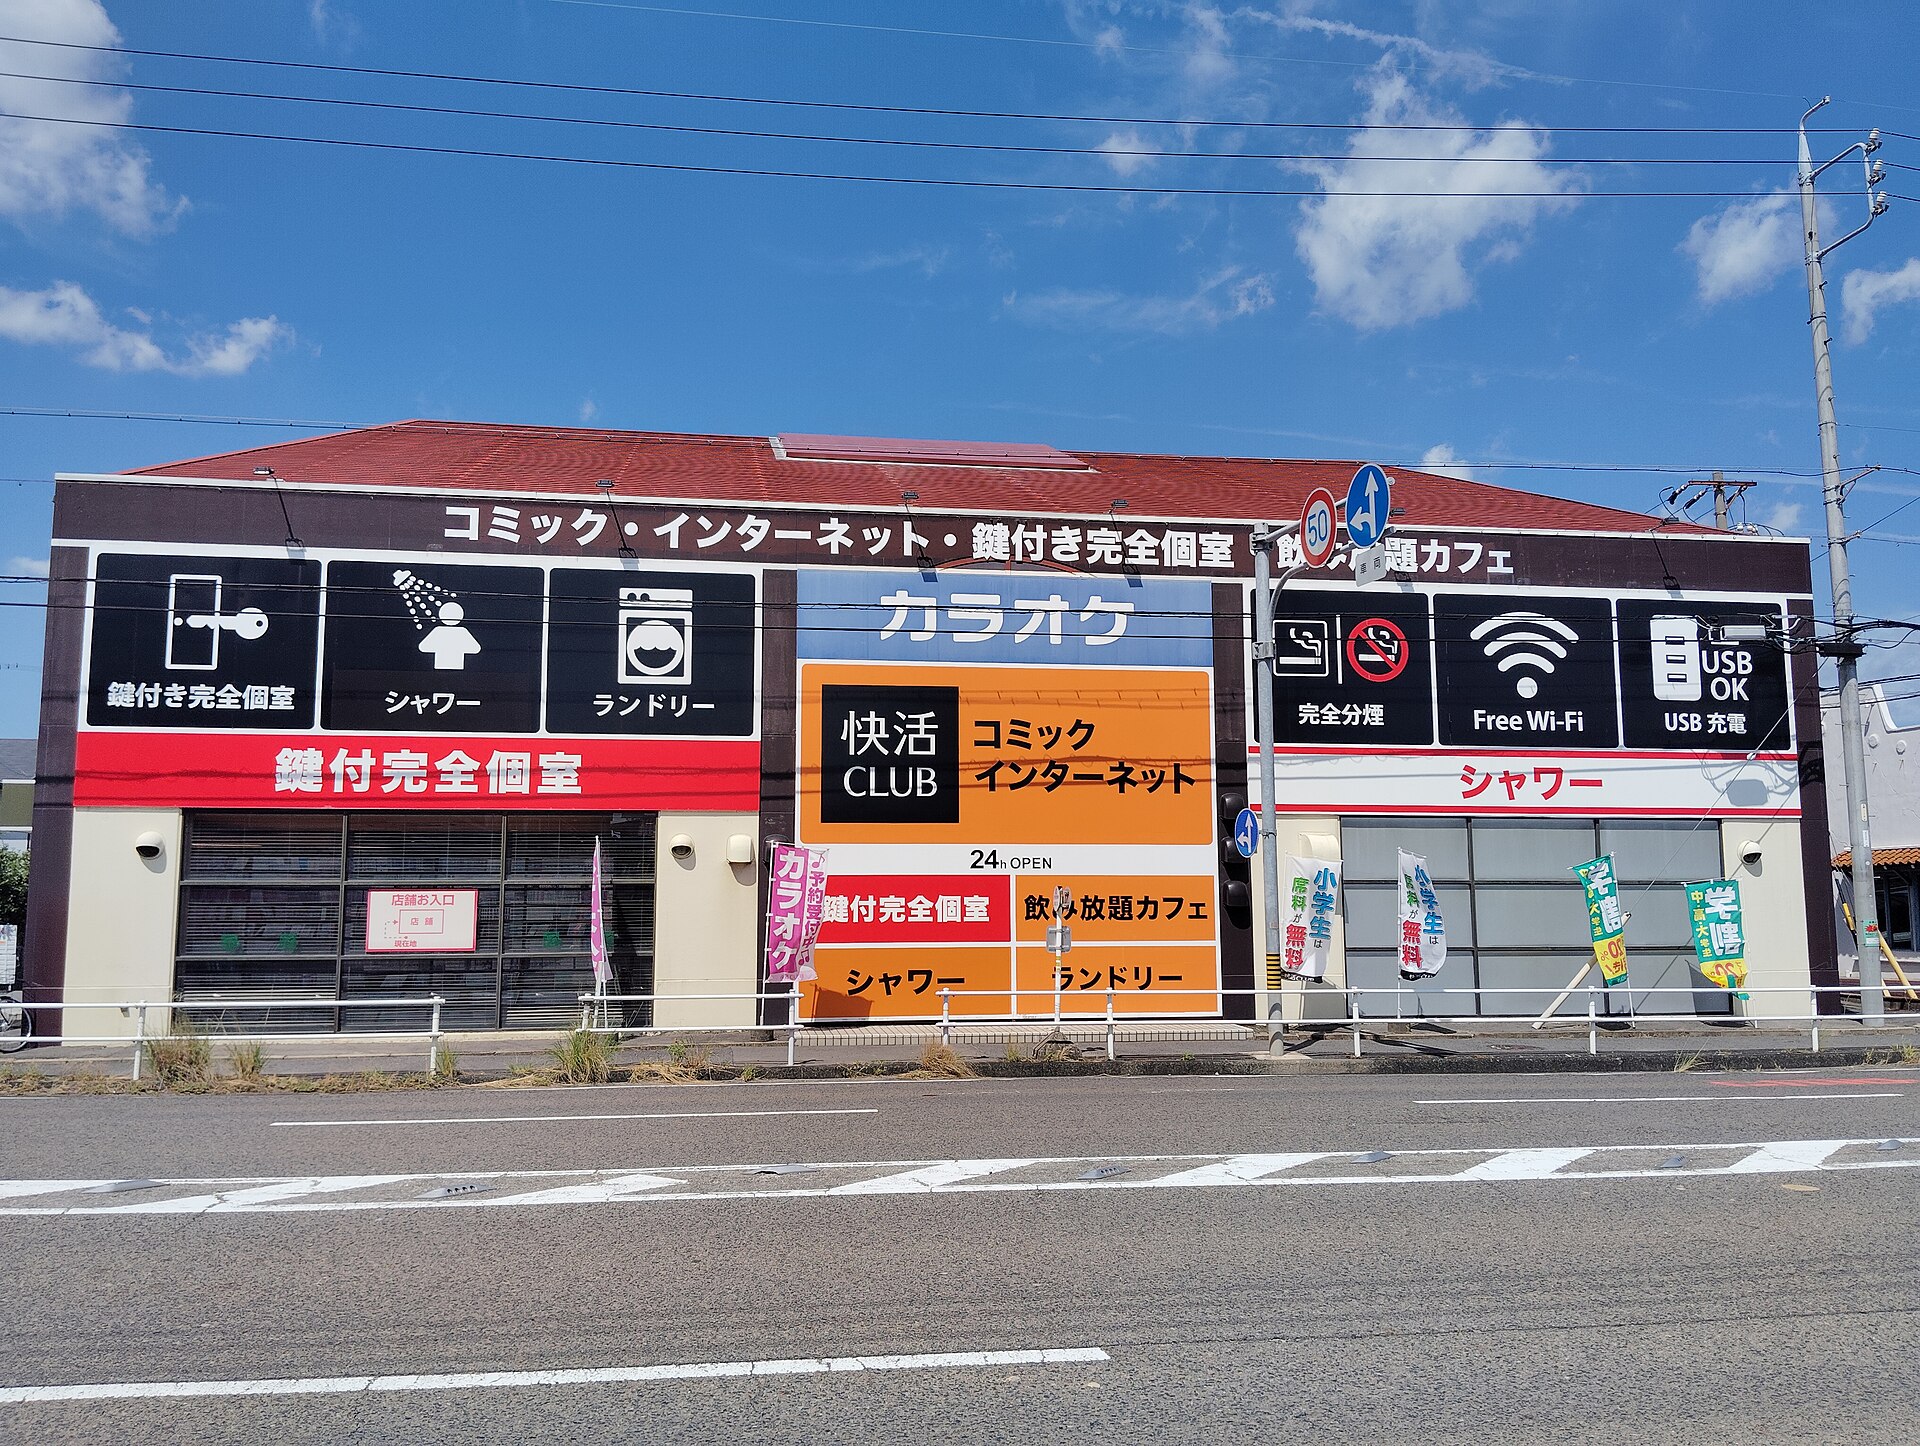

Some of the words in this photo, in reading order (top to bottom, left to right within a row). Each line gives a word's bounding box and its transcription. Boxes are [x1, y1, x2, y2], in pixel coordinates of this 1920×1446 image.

[1307, 508, 1328, 547] 50
[880, 589, 1136, 646] カラオケ
[1701, 650, 1753, 675] USB
[106, 681, 295, 711] 鍵付き完全個室
[384, 690, 481, 715] シャワー
[1710, 677, 1750, 701] OK
[593, 693, 715, 718] ランドリー
[1298, 702, 1385, 726] 完全分煙
[1473, 709, 1522, 731] Free
[1529, 710, 1584, 732] Wi-Fi
[840, 710, 939, 756] 快活
[973, 718, 1095, 751] コミック
[1664, 712, 1702, 732] USB
[1706, 712, 1748, 734] 充電
[274, 747, 583, 795] 鍵付完全個室
[843, 766, 938, 798] CLUB
[974, 760, 1196, 794] インターネット
[1460, 765, 1603, 801] シャワー
[1010, 857, 1052, 870] OPEN
[391, 894, 455, 906] 店舗お入口
[772, 851, 805, 970] カラオケ
[803, 870, 825, 949] 予約受付中
[822, 893, 990, 923] 鍵付完全個室
[1309, 867, 1338, 949] 小学生は
[846, 969, 965, 996] シャワー
[1051, 965, 1184, 991] ランドリー
